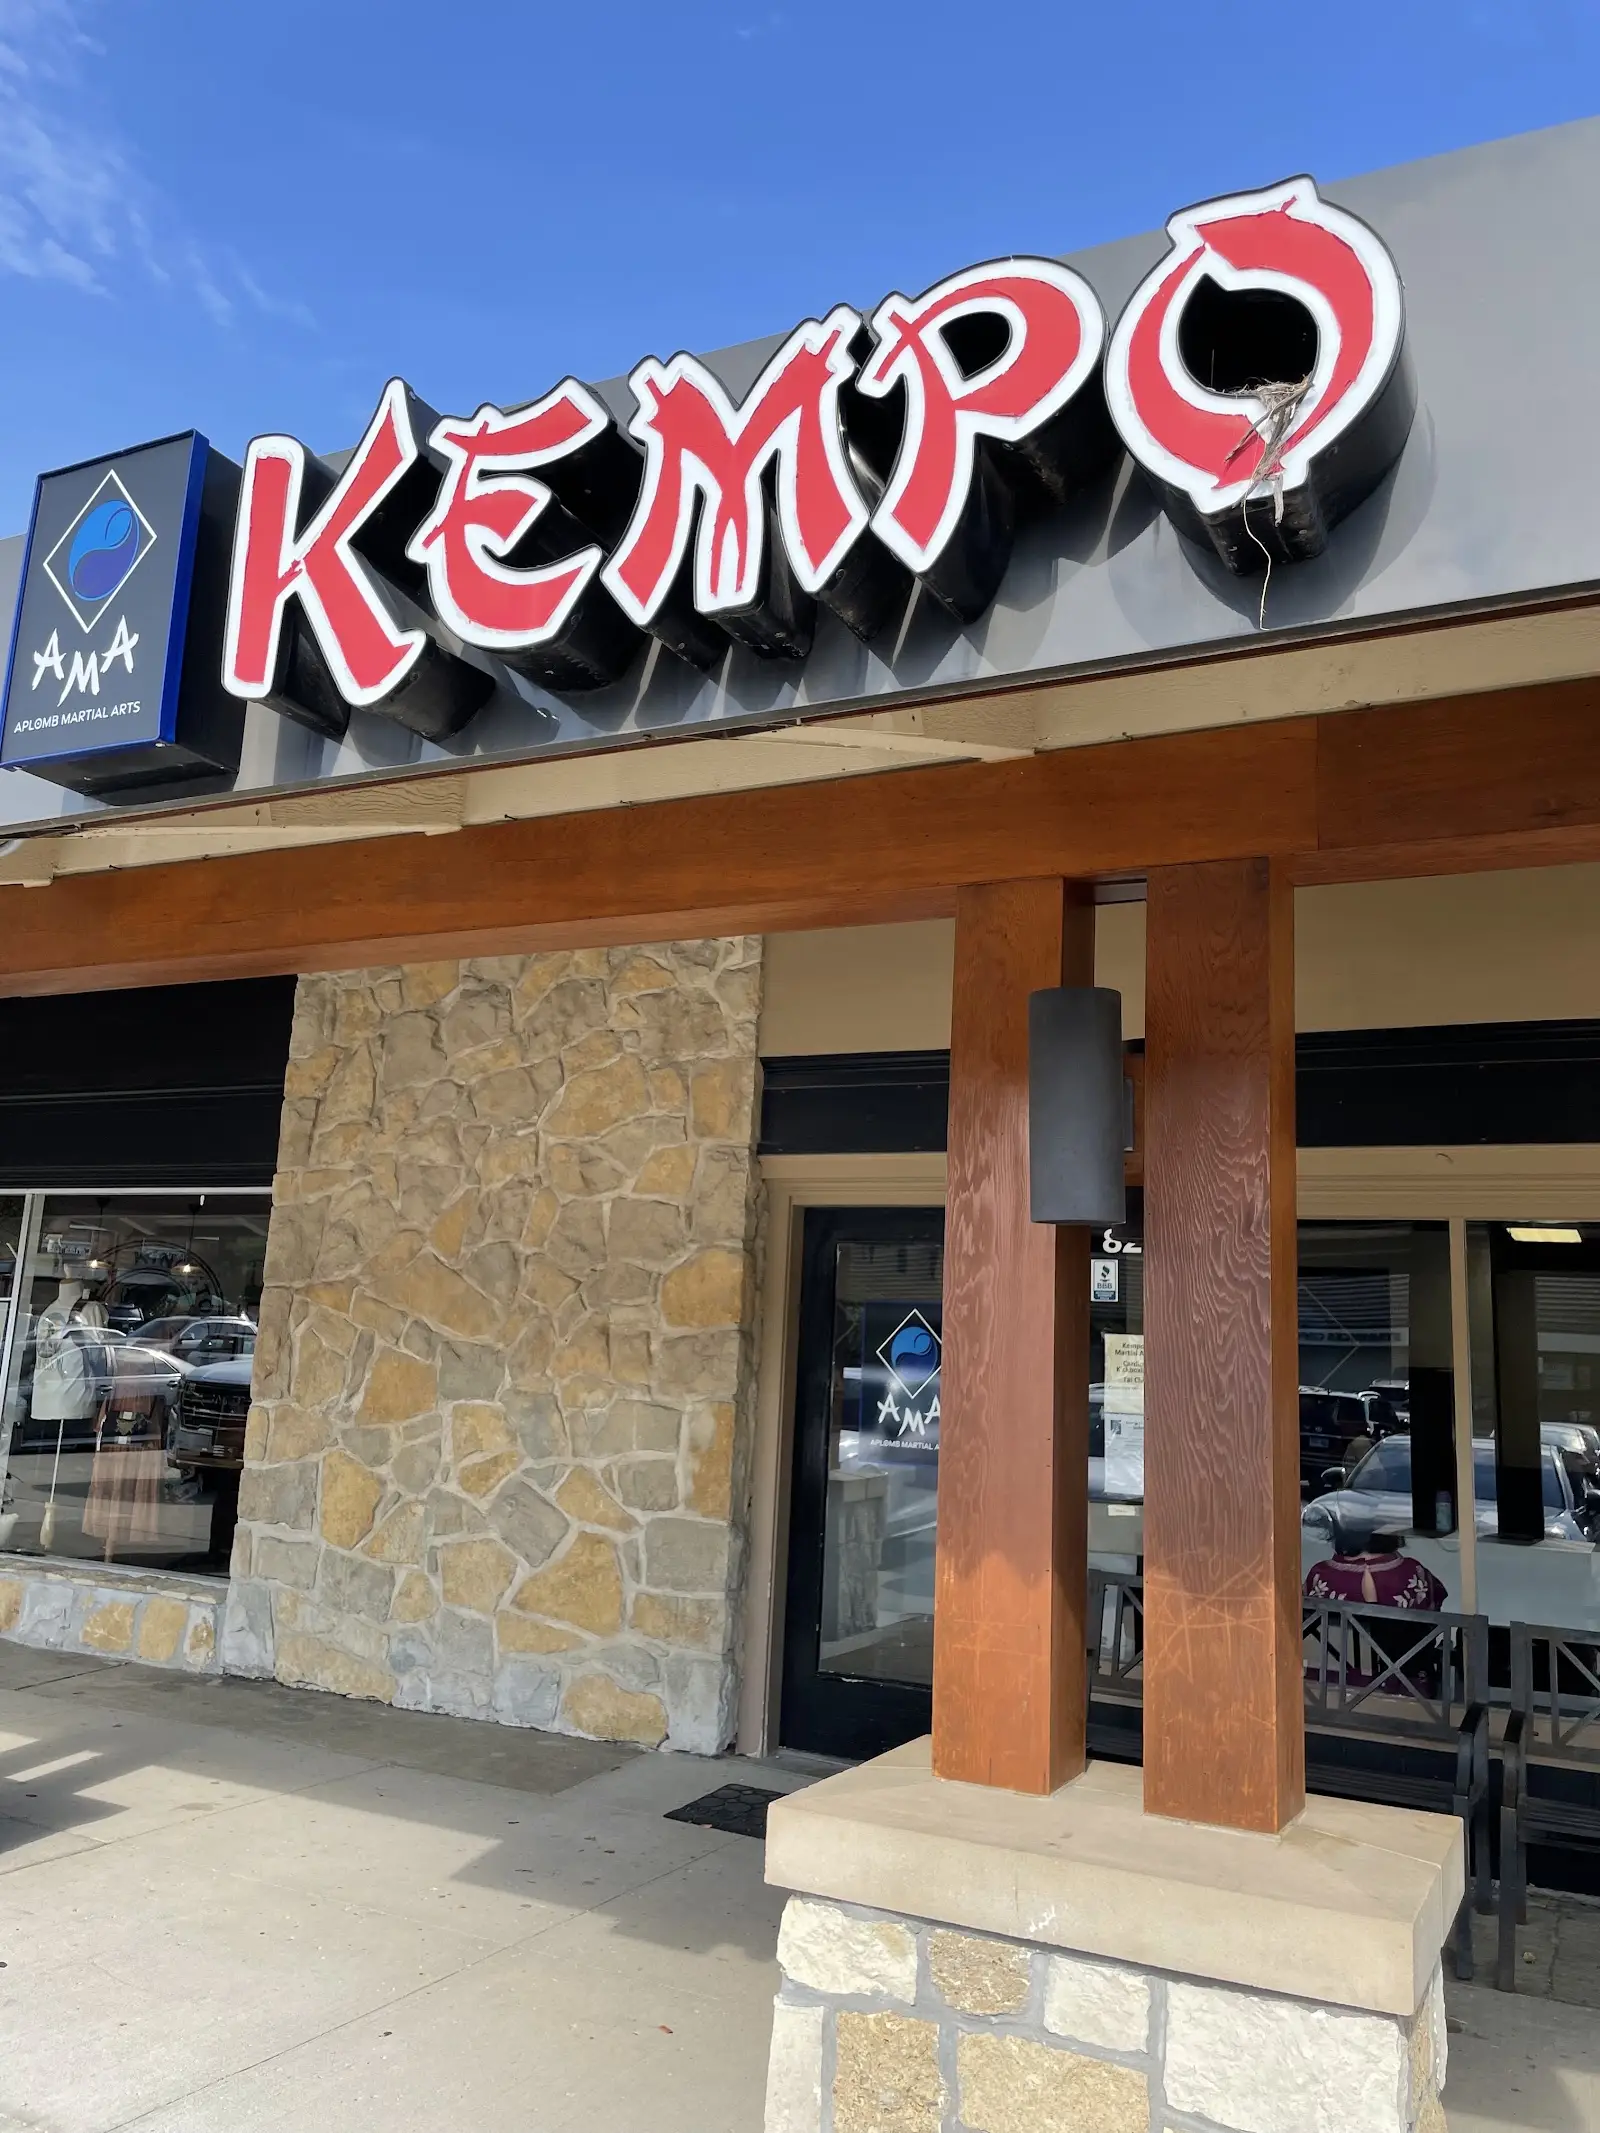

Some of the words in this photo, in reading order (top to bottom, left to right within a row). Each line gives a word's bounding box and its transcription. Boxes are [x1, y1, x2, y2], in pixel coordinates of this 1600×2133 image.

[221, 175, 1405, 709] KEMPO
[32, 615, 139, 706] AMA
[14, 716, 59, 734] APLOMB
[61, 708, 108, 726] MARTIAL
[110, 701, 141, 717] ARTS
[877, 1391, 940, 1437] AMA
[870, 1439, 901, 1448] APLOMB
[901, 1440, 933, 1450] MARTIAL
